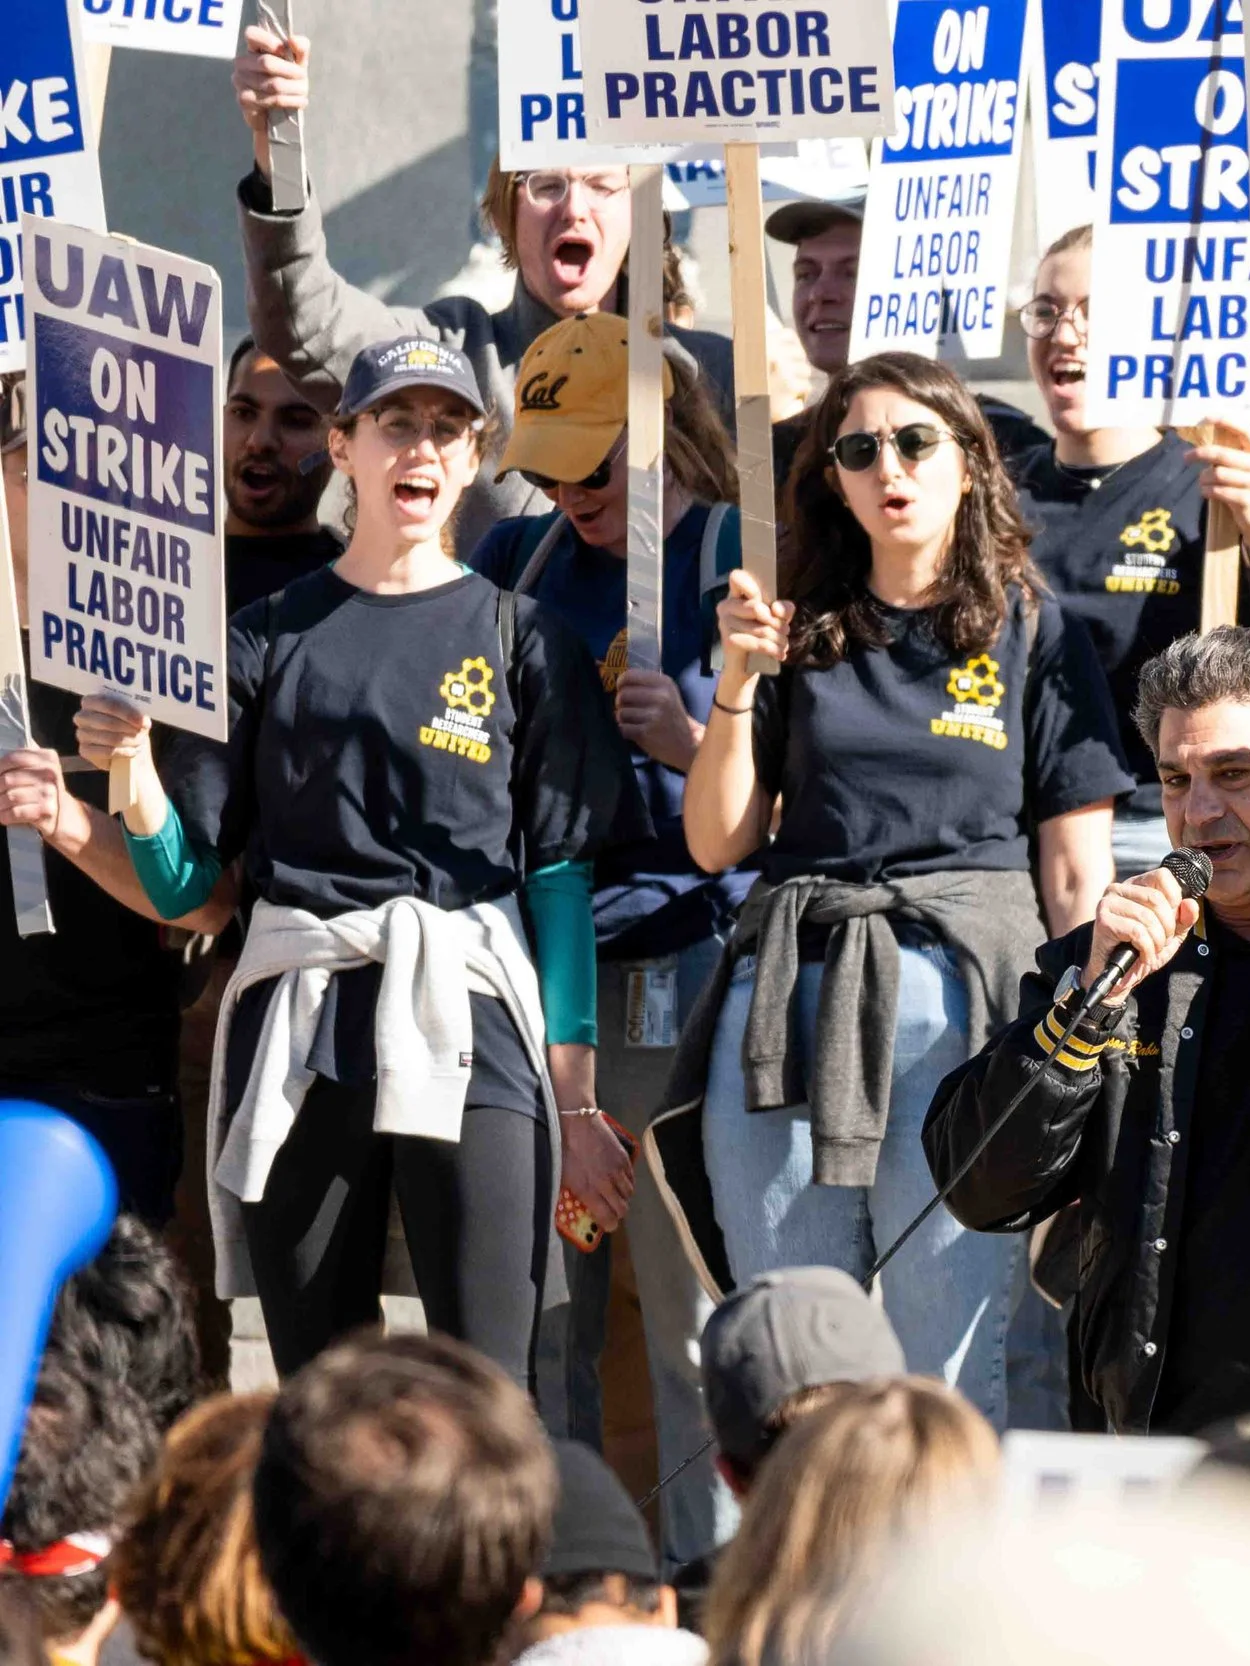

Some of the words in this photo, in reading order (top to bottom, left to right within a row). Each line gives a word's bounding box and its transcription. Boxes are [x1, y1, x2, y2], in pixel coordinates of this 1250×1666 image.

[645, 11, 831, 60] LABOR
[932, 6, 989, 74] ON
[604, 66, 880, 118] PRACTICE
[886, 78, 1017, 151] STRIKE
[1052, 62, 1100, 126] S
[895, 172, 991, 222] UNFAIR
[894, 230, 980, 279] LABOR
[35, 234, 212, 347] UAW
[865, 286, 996, 338] PRACTICE
[90, 347, 156, 424] ON
[520, 372, 570, 412] Cal
[42, 408, 209, 515] STRIKE
[62, 501, 191, 589] UNFAIR
[68, 562, 185, 645] LABOR
[43, 610, 216, 712] PRACTICE
[420, 726, 491, 764] UNITED
